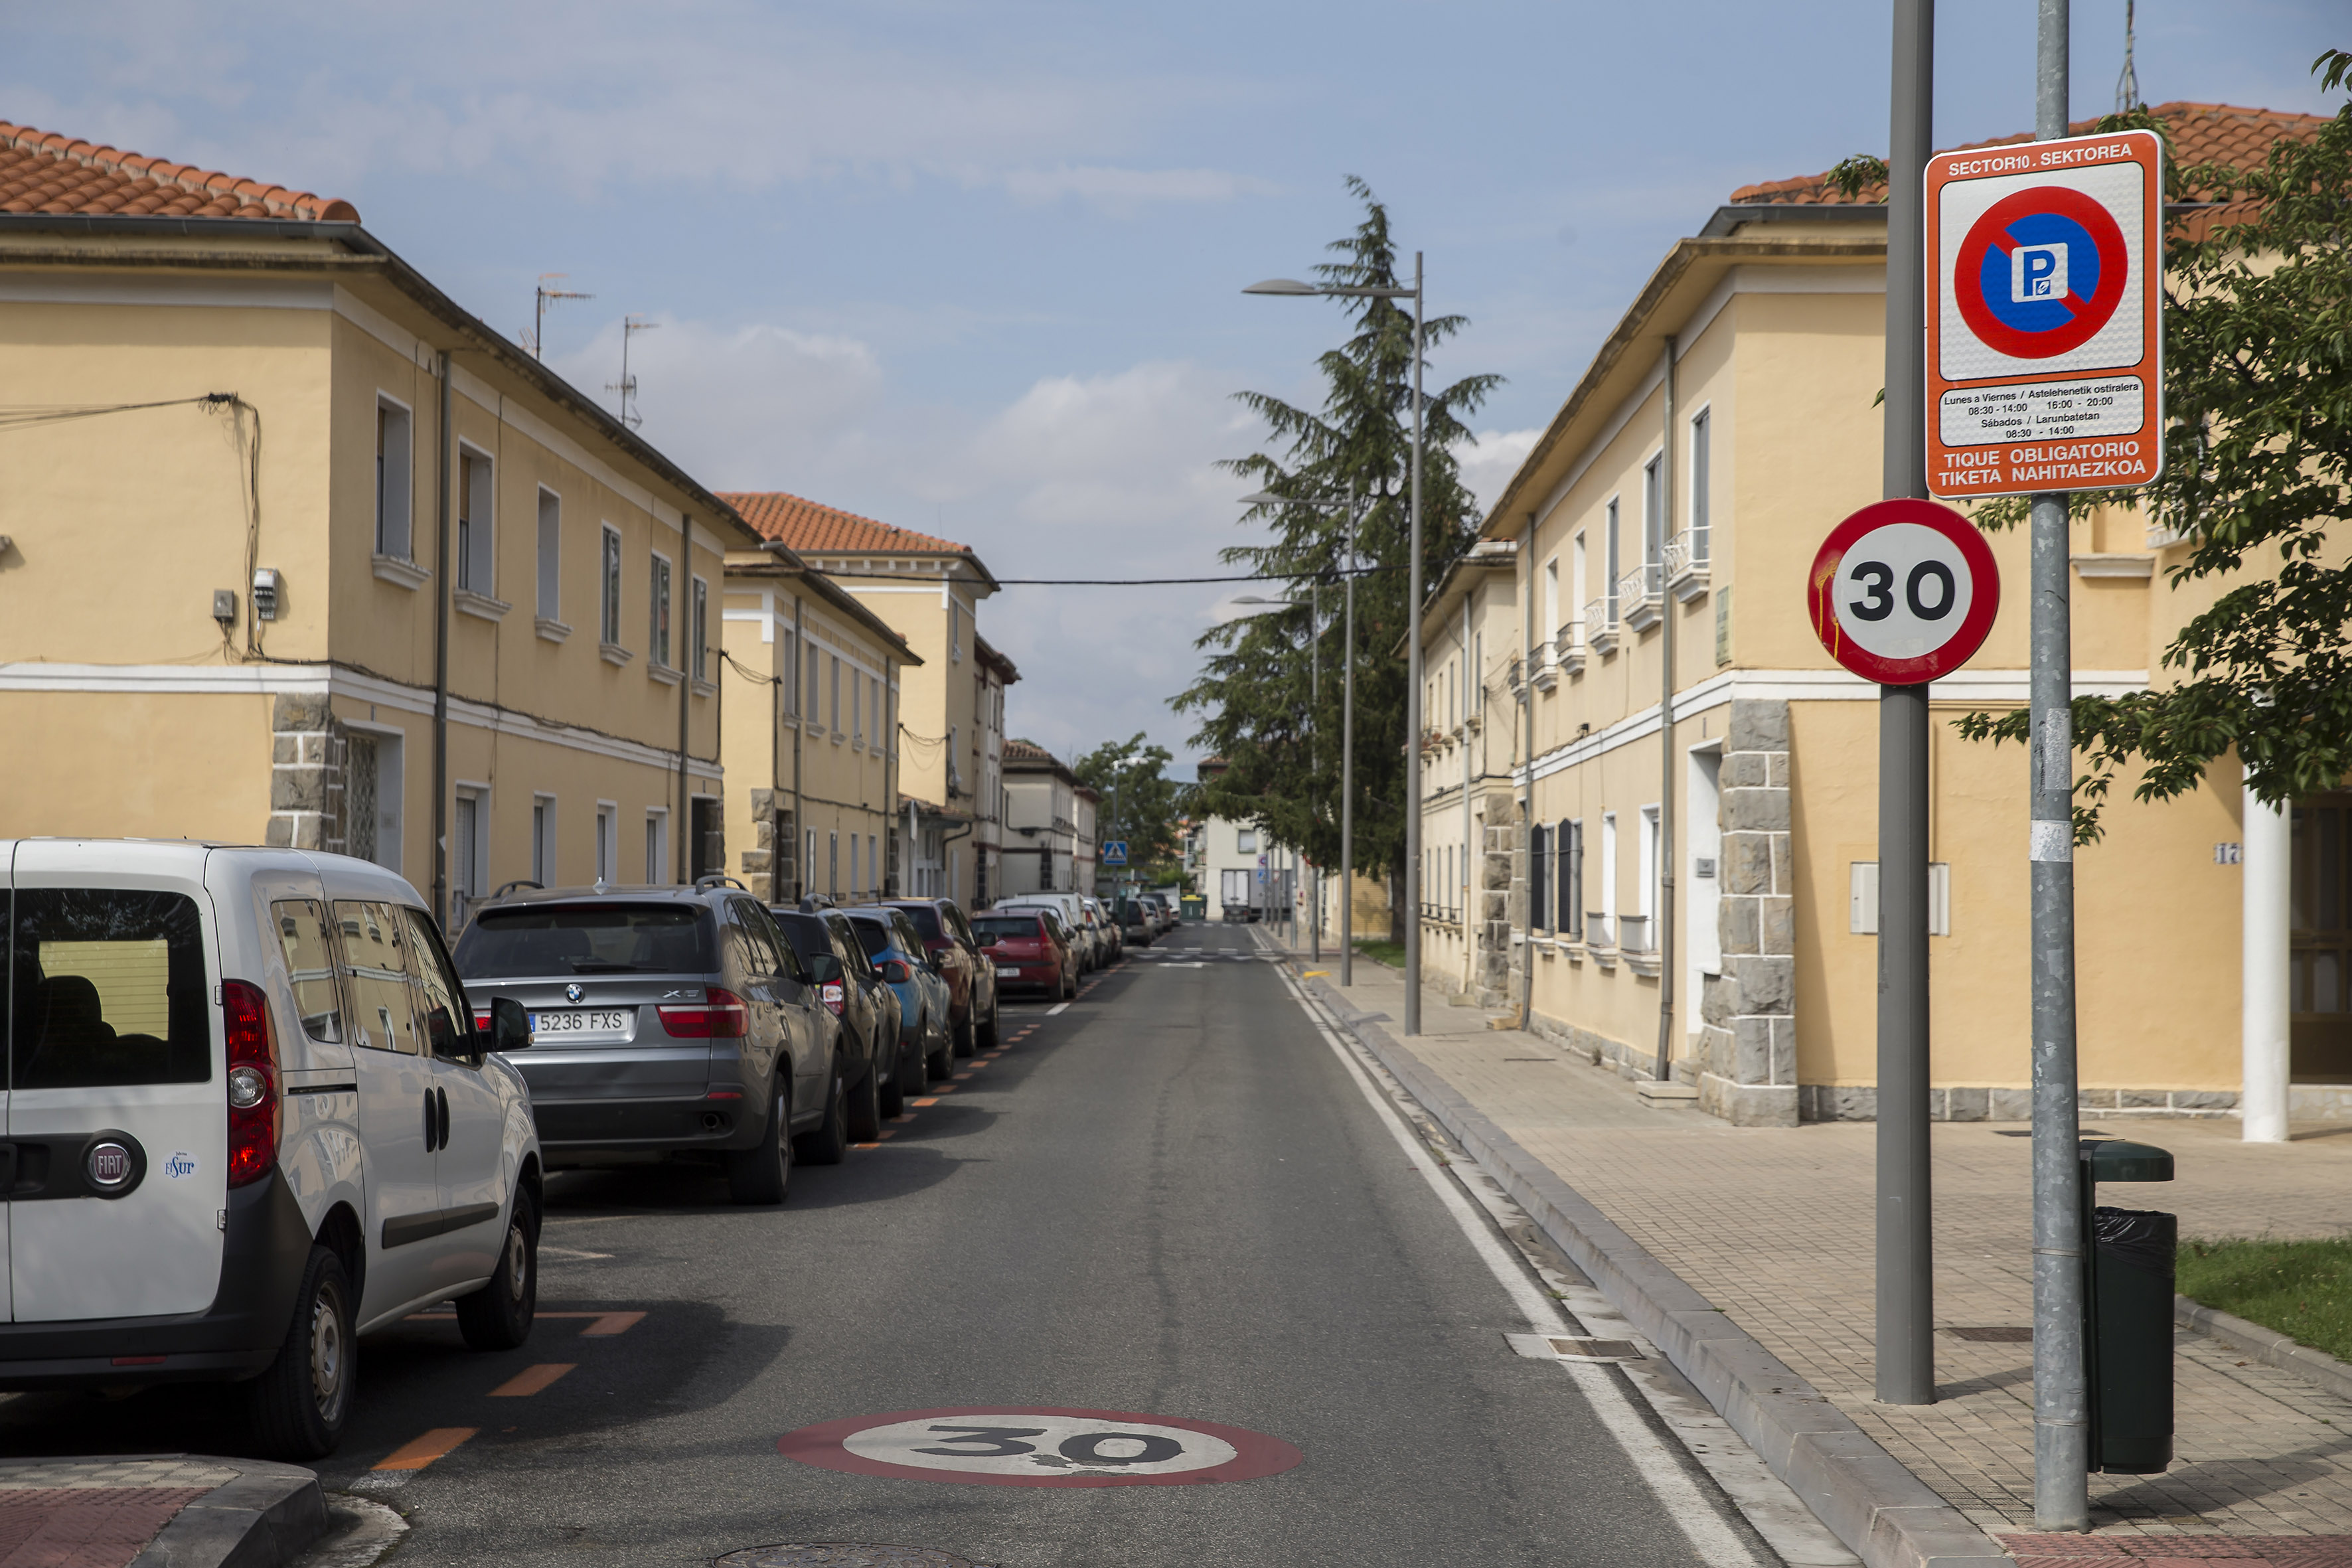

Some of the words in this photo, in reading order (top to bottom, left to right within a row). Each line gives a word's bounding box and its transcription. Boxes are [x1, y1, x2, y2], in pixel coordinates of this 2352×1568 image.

[2041, 143, 2132, 167] SEKTOREA
[2023, 250, 2057, 297] P
[1944, 396, 1972, 406] Lunes
[1982, 392, 2016, 402] Viernes
[2029, 386, 2092, 399] Astelehenetik
[2094, 383, 2138, 394] ostiralera
[1968, 406, 1993, 416] 08:30
[2002, 404, 2027, 413] 14:00
[2047, 400, 2073, 410] 16:00
[2087, 397, 2113, 406] 20:00
[1982, 417, 2022, 428] Sábados
[2036, 412, 2100, 424] Larunbatetan
[2006, 429, 2031, 438] 08:30
[2049, 426, 2074, 435] 14:00
[1944, 451, 1999, 468] TIQUE
[2010, 441, 2139, 463] OBLIGATORIO
[1938, 469, 2002, 486] TIKETA
[2012, 459, 2146, 482] NAHITAEZKOA
[1849, 560, 1956, 621] 30
[541, 1014, 582, 1030] 5236
[590, 1012, 621, 1029] FXS
[98, 1155, 121, 1174] FIAT
[910, 1425, 1186, 1464] 30
